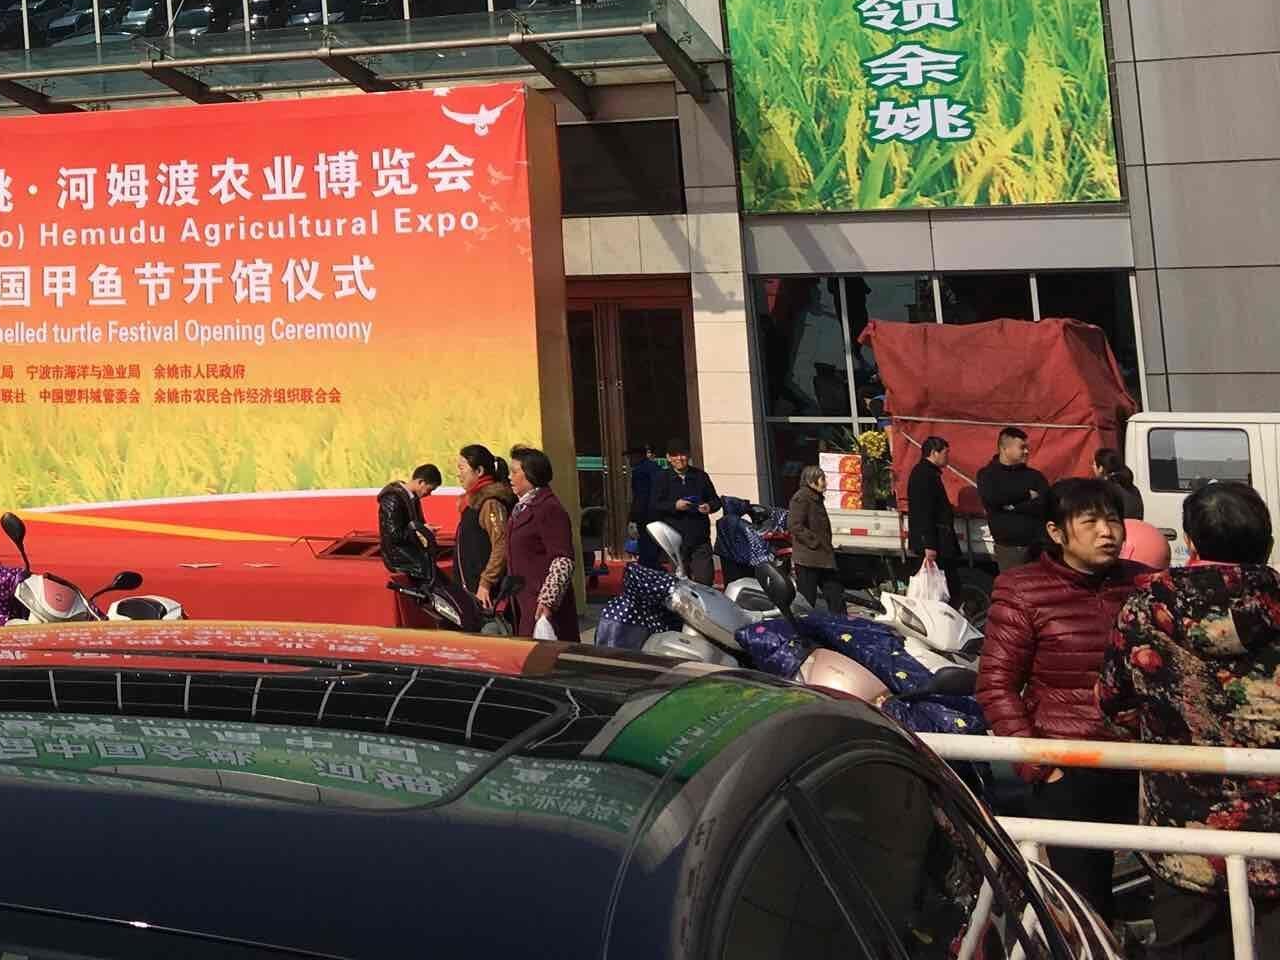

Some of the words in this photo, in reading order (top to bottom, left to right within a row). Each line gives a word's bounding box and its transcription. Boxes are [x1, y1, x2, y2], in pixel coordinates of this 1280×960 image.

[39, 219, 166, 246] Hemudu
[181, 209, 378, 246] Agricultural
[394, 208, 479, 237] Expo
[52, 321, 100, 343] turtle
[107, 319, 178, 343] Festival
[184, 319, 265, 346] Opening
[271, 317, 372, 344] Ceremony
